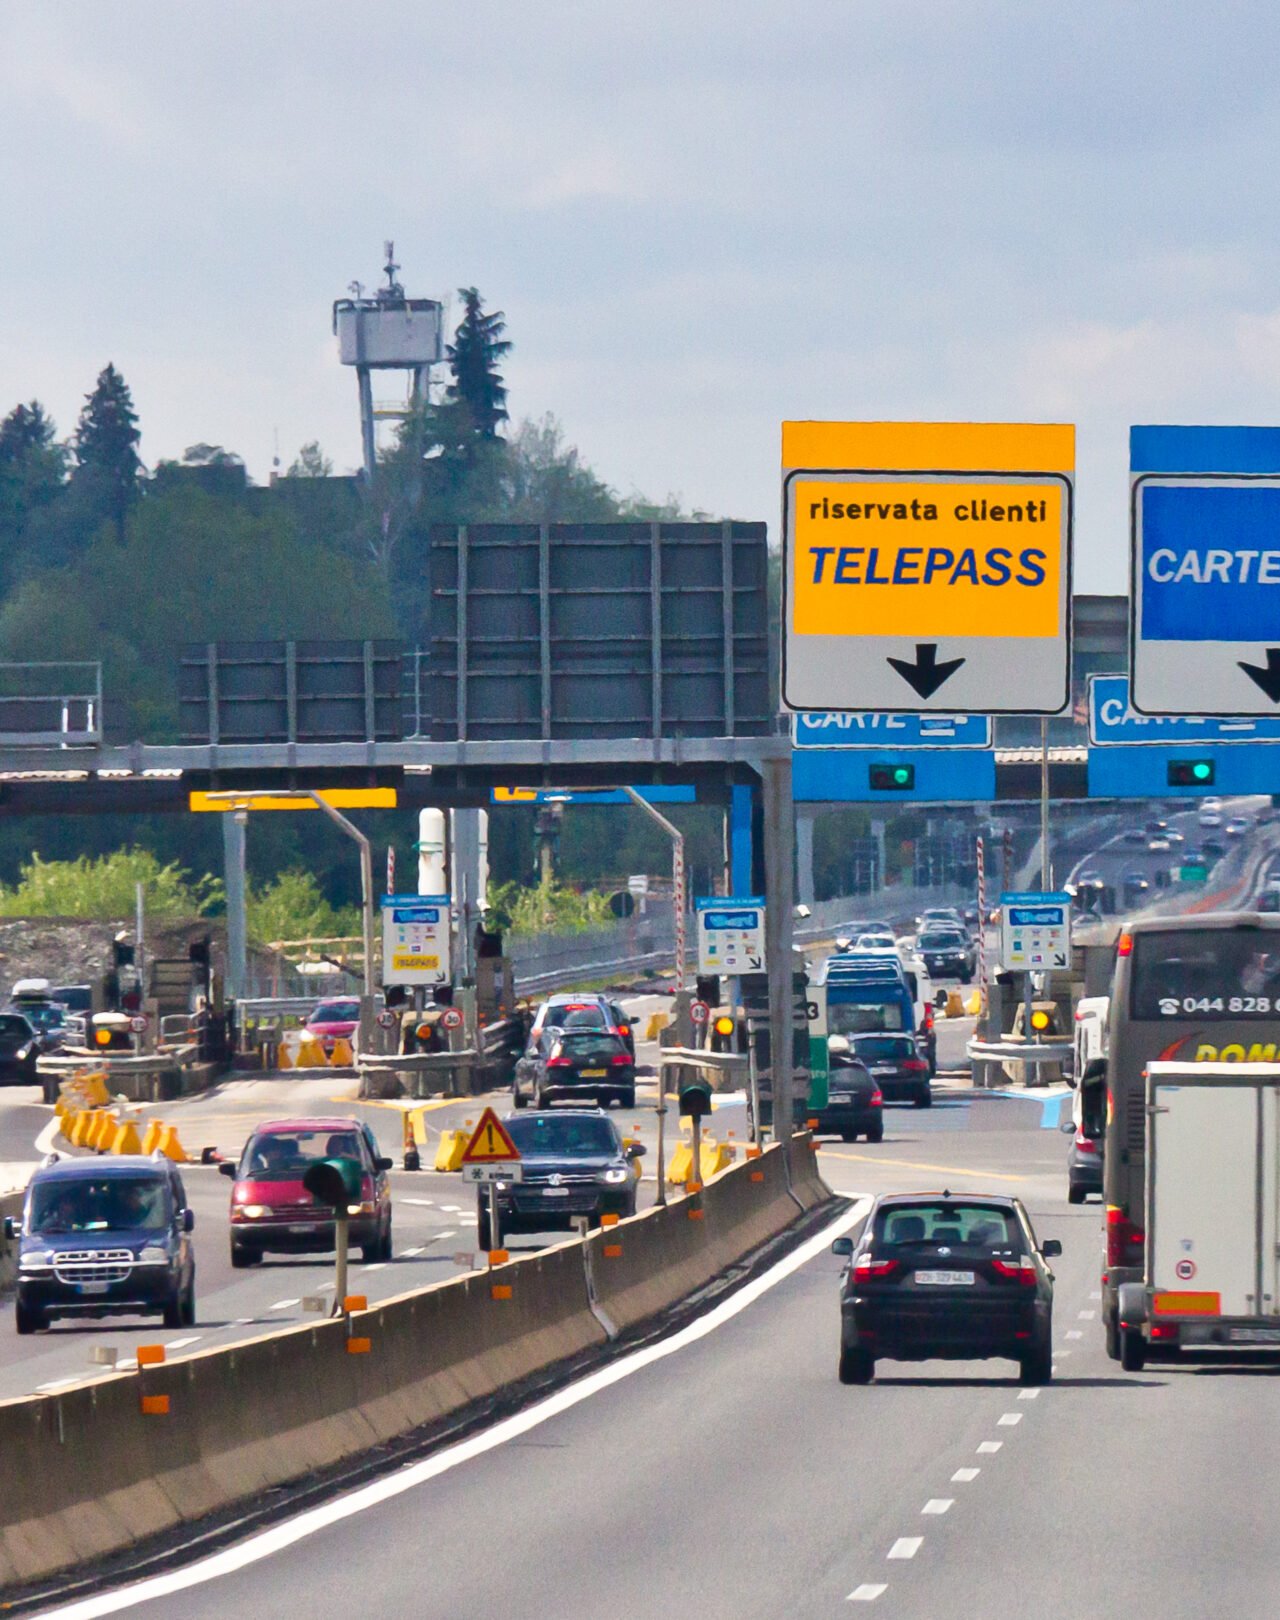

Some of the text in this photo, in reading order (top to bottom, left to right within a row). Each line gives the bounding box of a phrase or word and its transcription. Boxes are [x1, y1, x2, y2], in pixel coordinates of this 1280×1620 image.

[809, 497, 1046, 522] riservata clienti
[808, 547, 1048, 587] TELEPASS
[1183, 997, 1223, 1013] 044
[1228, 997, 1271, 1013] 828
